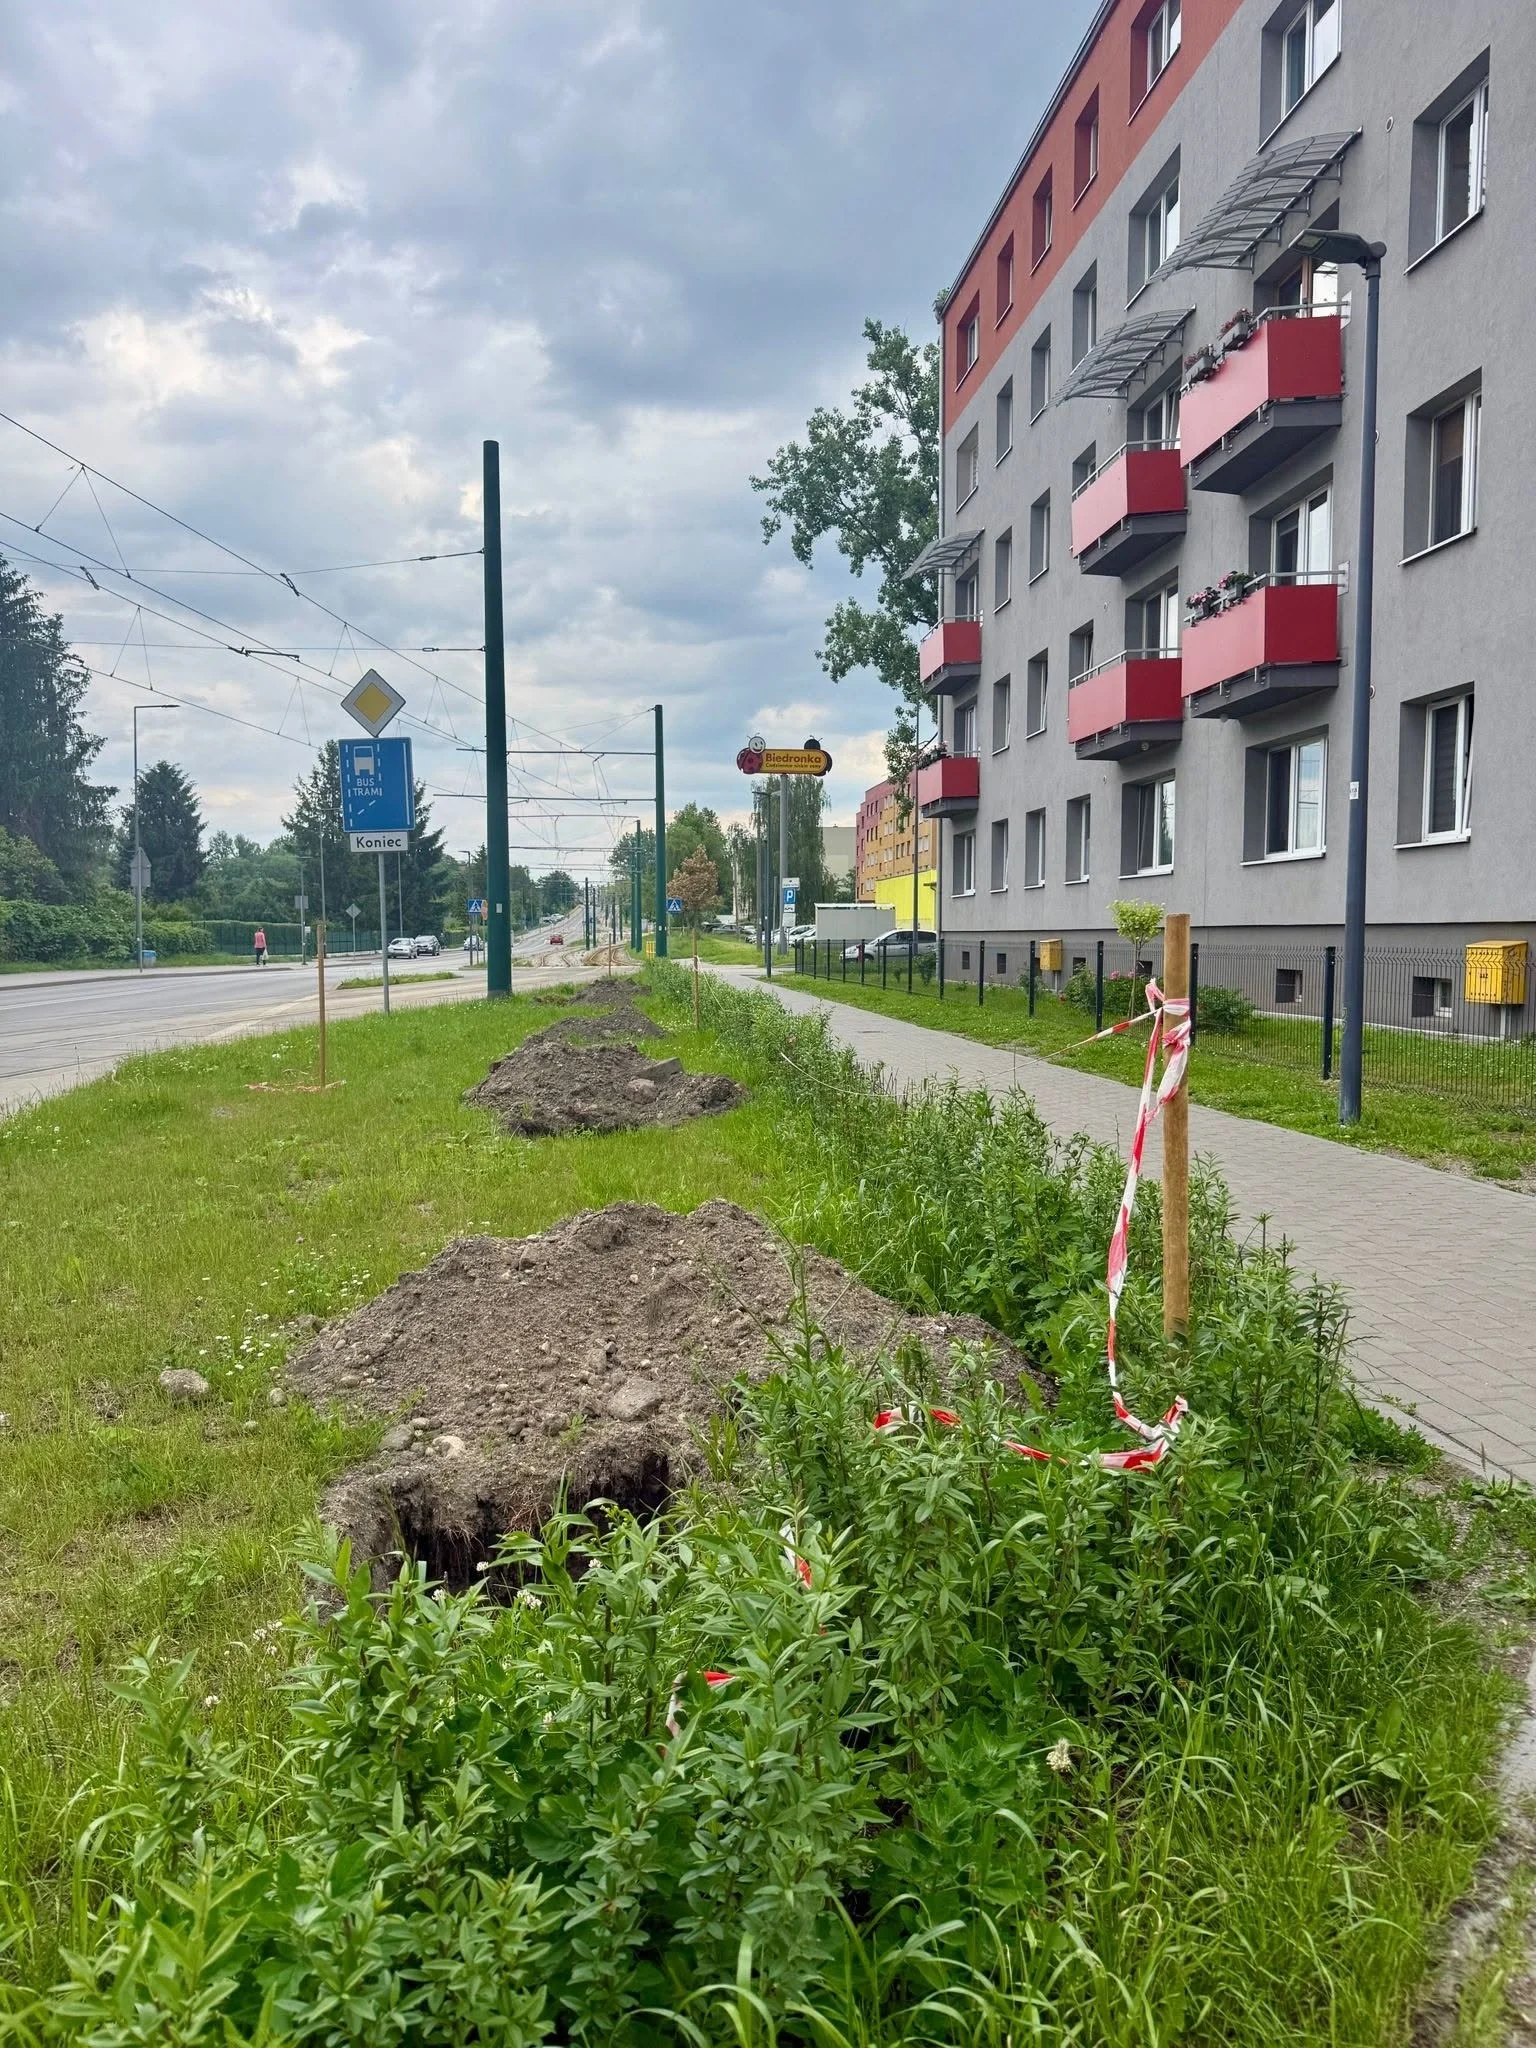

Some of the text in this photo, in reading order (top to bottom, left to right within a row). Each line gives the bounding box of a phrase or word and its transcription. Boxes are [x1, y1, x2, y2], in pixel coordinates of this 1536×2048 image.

[765, 753, 821, 763] Biedronka
[356, 778, 375, 787] BUS
[353, 788, 379, 796] TRAM
[356, 836, 402, 848] Koniec
[786, 890, 793, 902] P
